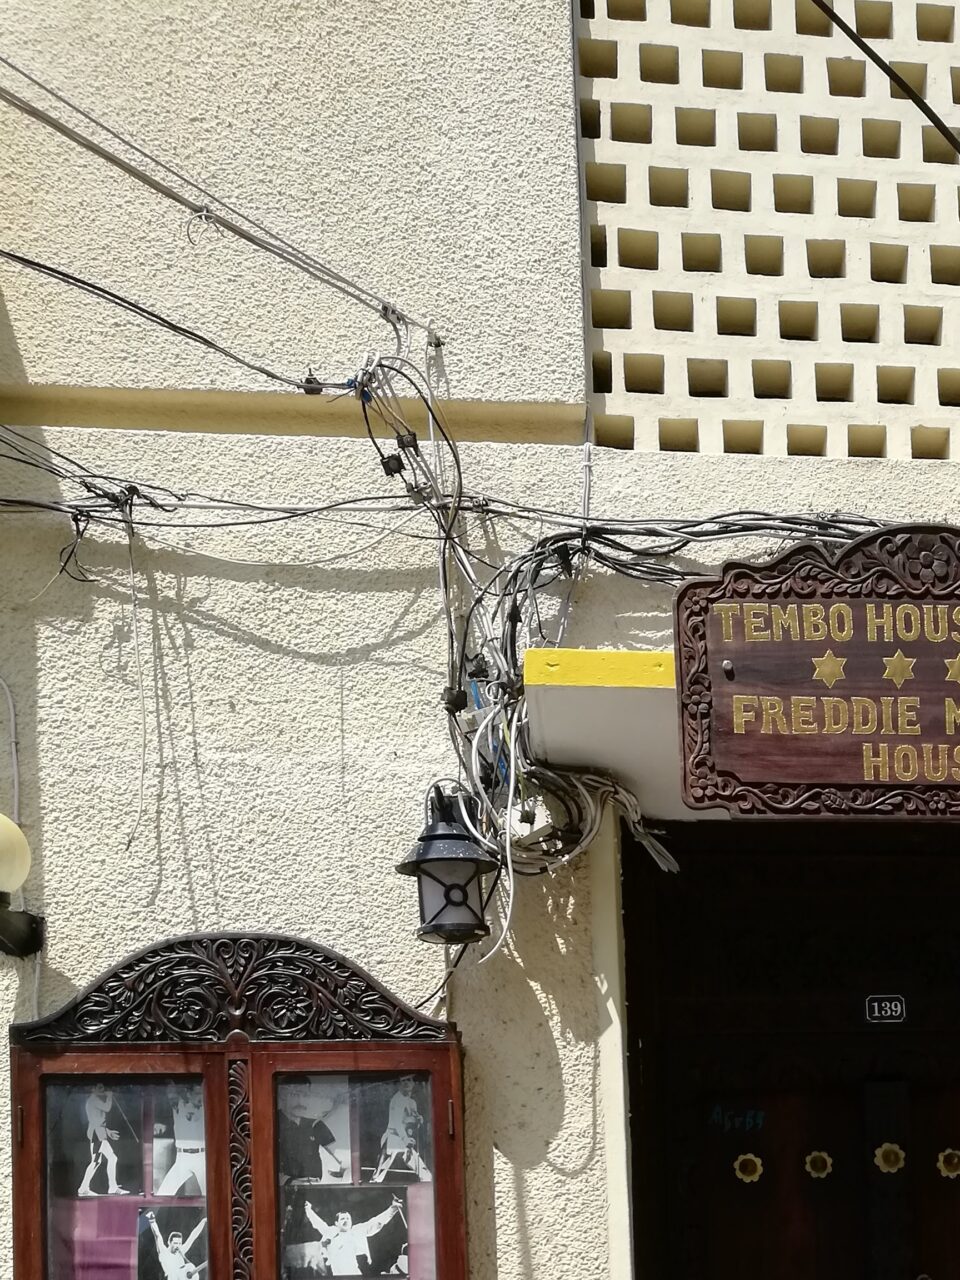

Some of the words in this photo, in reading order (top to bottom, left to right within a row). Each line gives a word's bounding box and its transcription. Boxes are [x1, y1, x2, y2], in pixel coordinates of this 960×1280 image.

[713, 602, 854, 642] TEMBO
[732, 695, 921, 735] FREDDIE
[871, 1001, 902, 1017] 139
